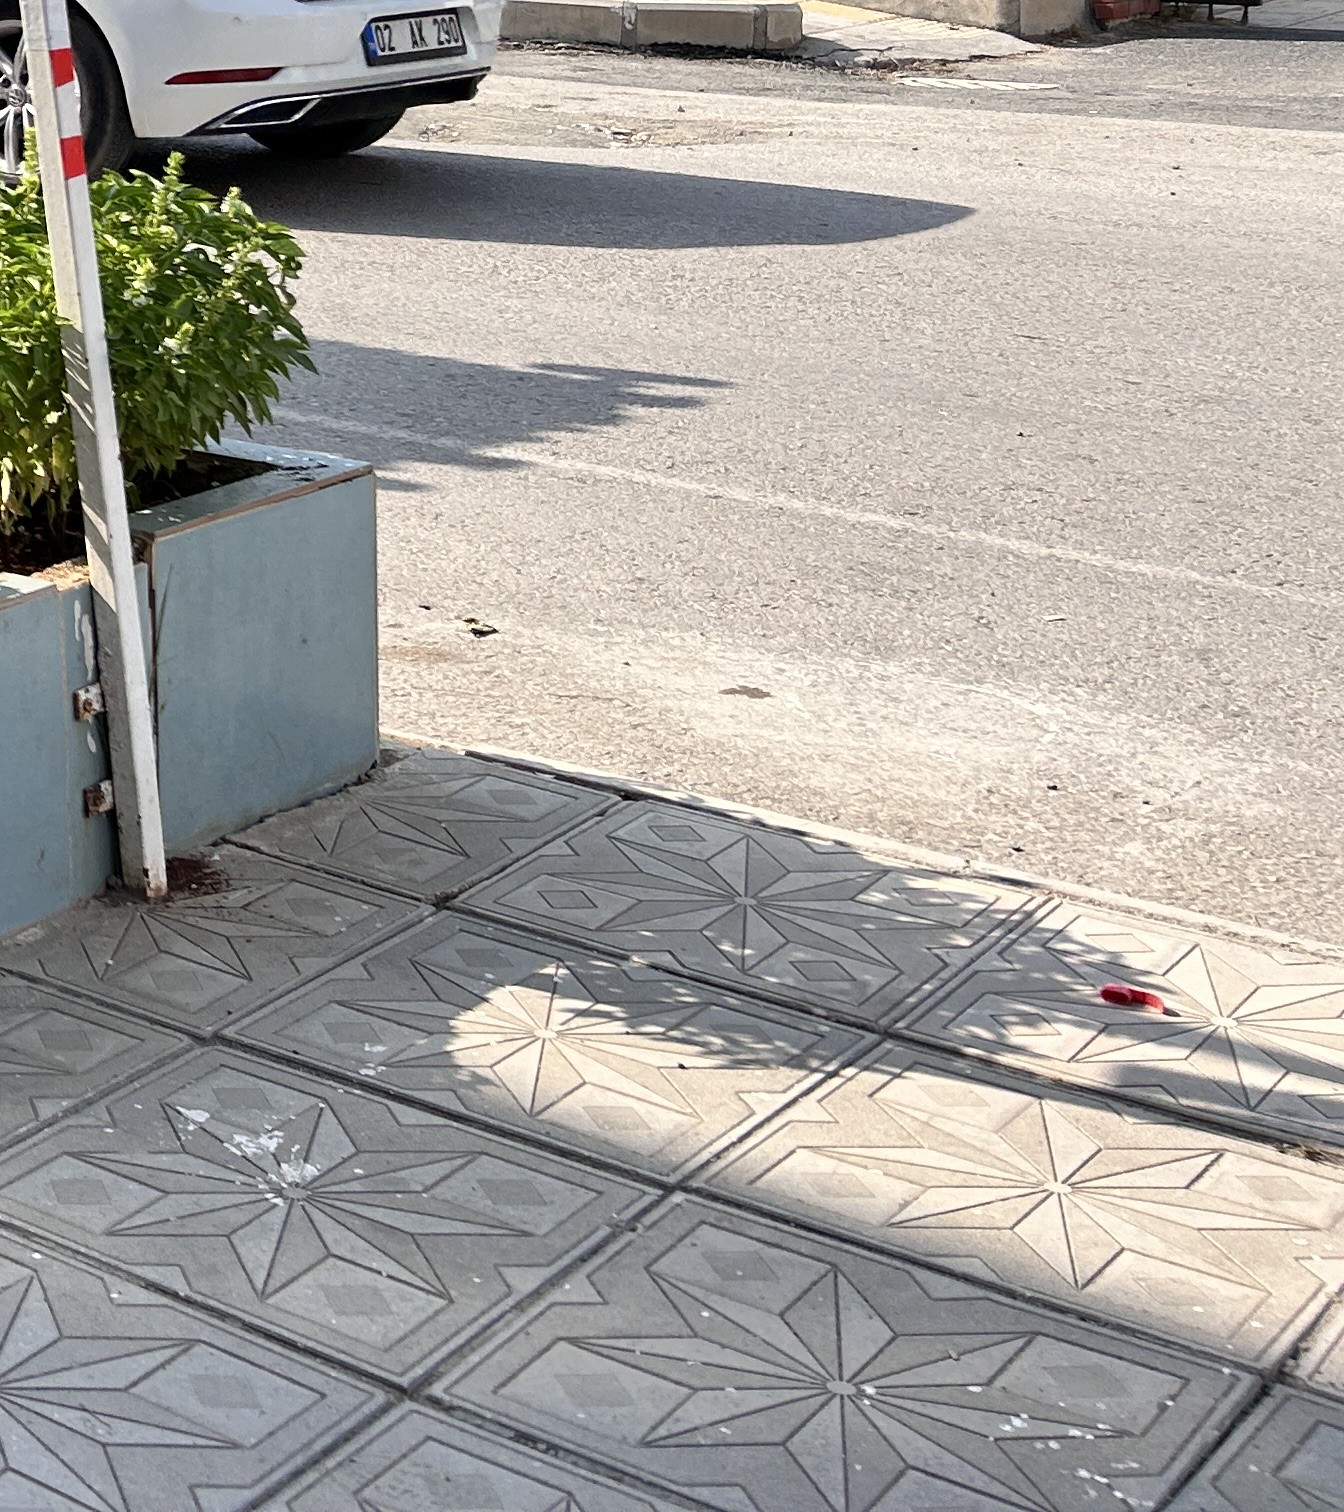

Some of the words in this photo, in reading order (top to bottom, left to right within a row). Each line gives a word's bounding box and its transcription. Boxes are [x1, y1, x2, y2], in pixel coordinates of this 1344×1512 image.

[373, 24, 396, 53] 02
[409, 20, 429, 50] AK
[432, 16, 460, 47] 290
